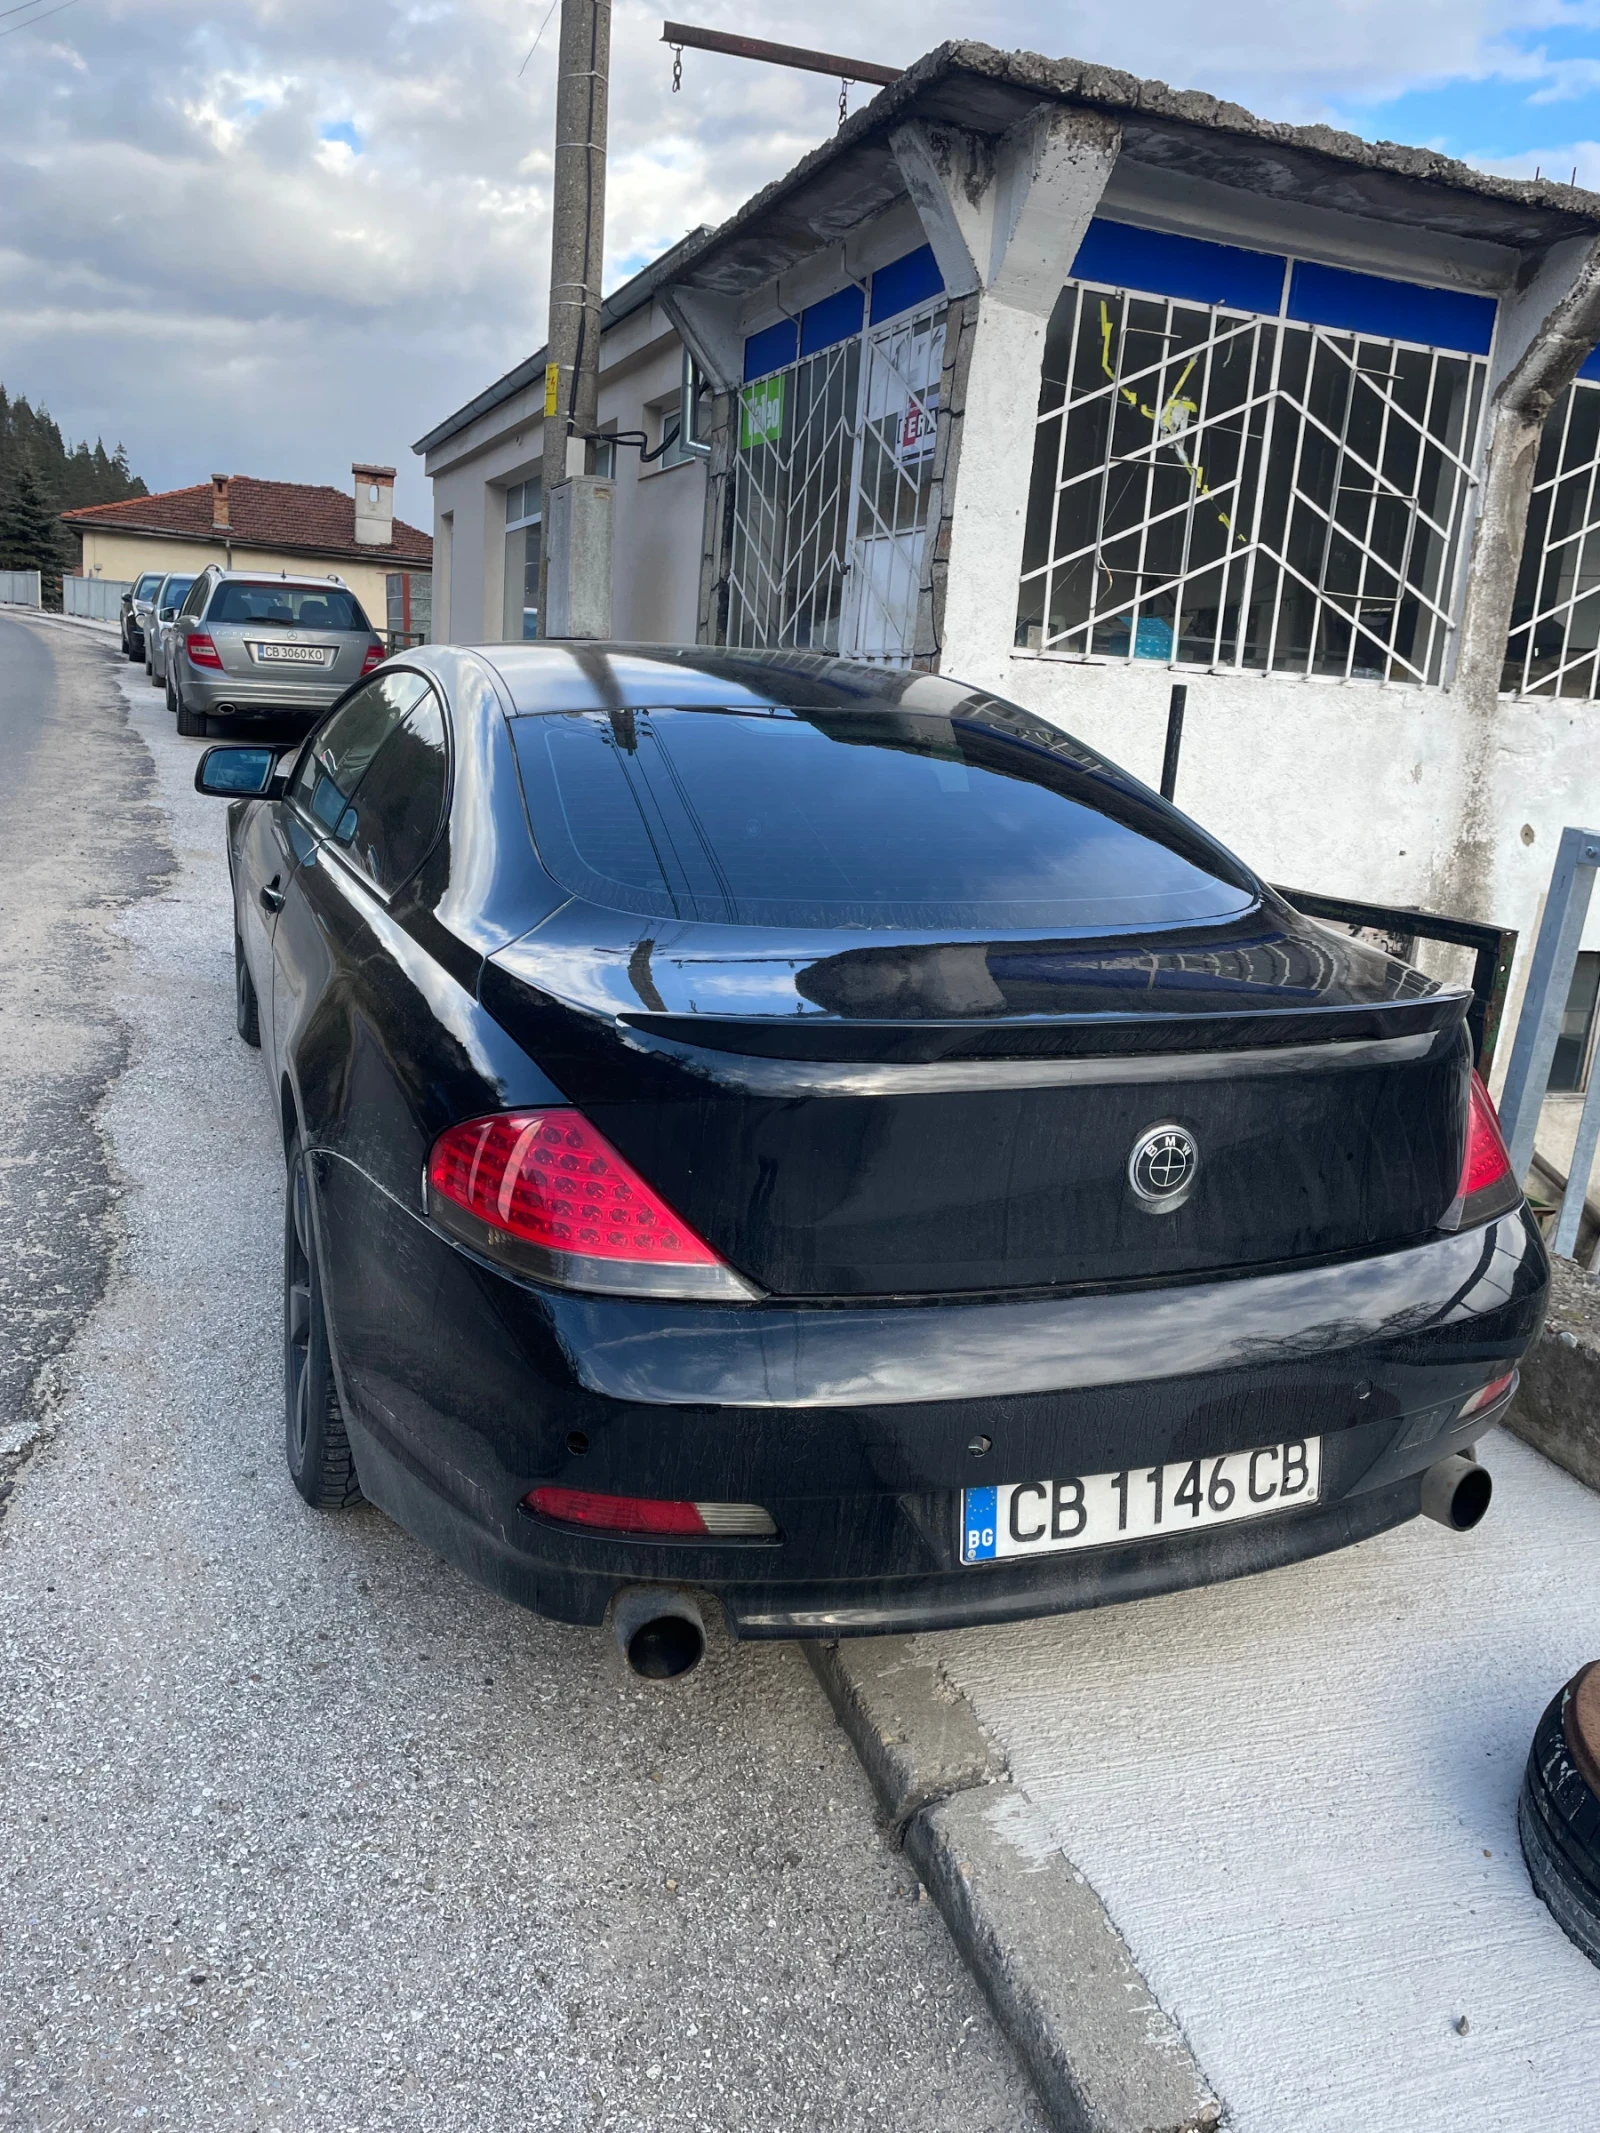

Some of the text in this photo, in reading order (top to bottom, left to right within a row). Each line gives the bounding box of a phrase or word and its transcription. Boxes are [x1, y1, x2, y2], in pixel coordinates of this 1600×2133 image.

[265, 646, 323, 660] CB 3060 KO
[1144, 1135, 1192, 1158] BMW
[1009, 1439, 1310, 1543] CB 1146 CB
[967, 1527, 994, 1549] BG
